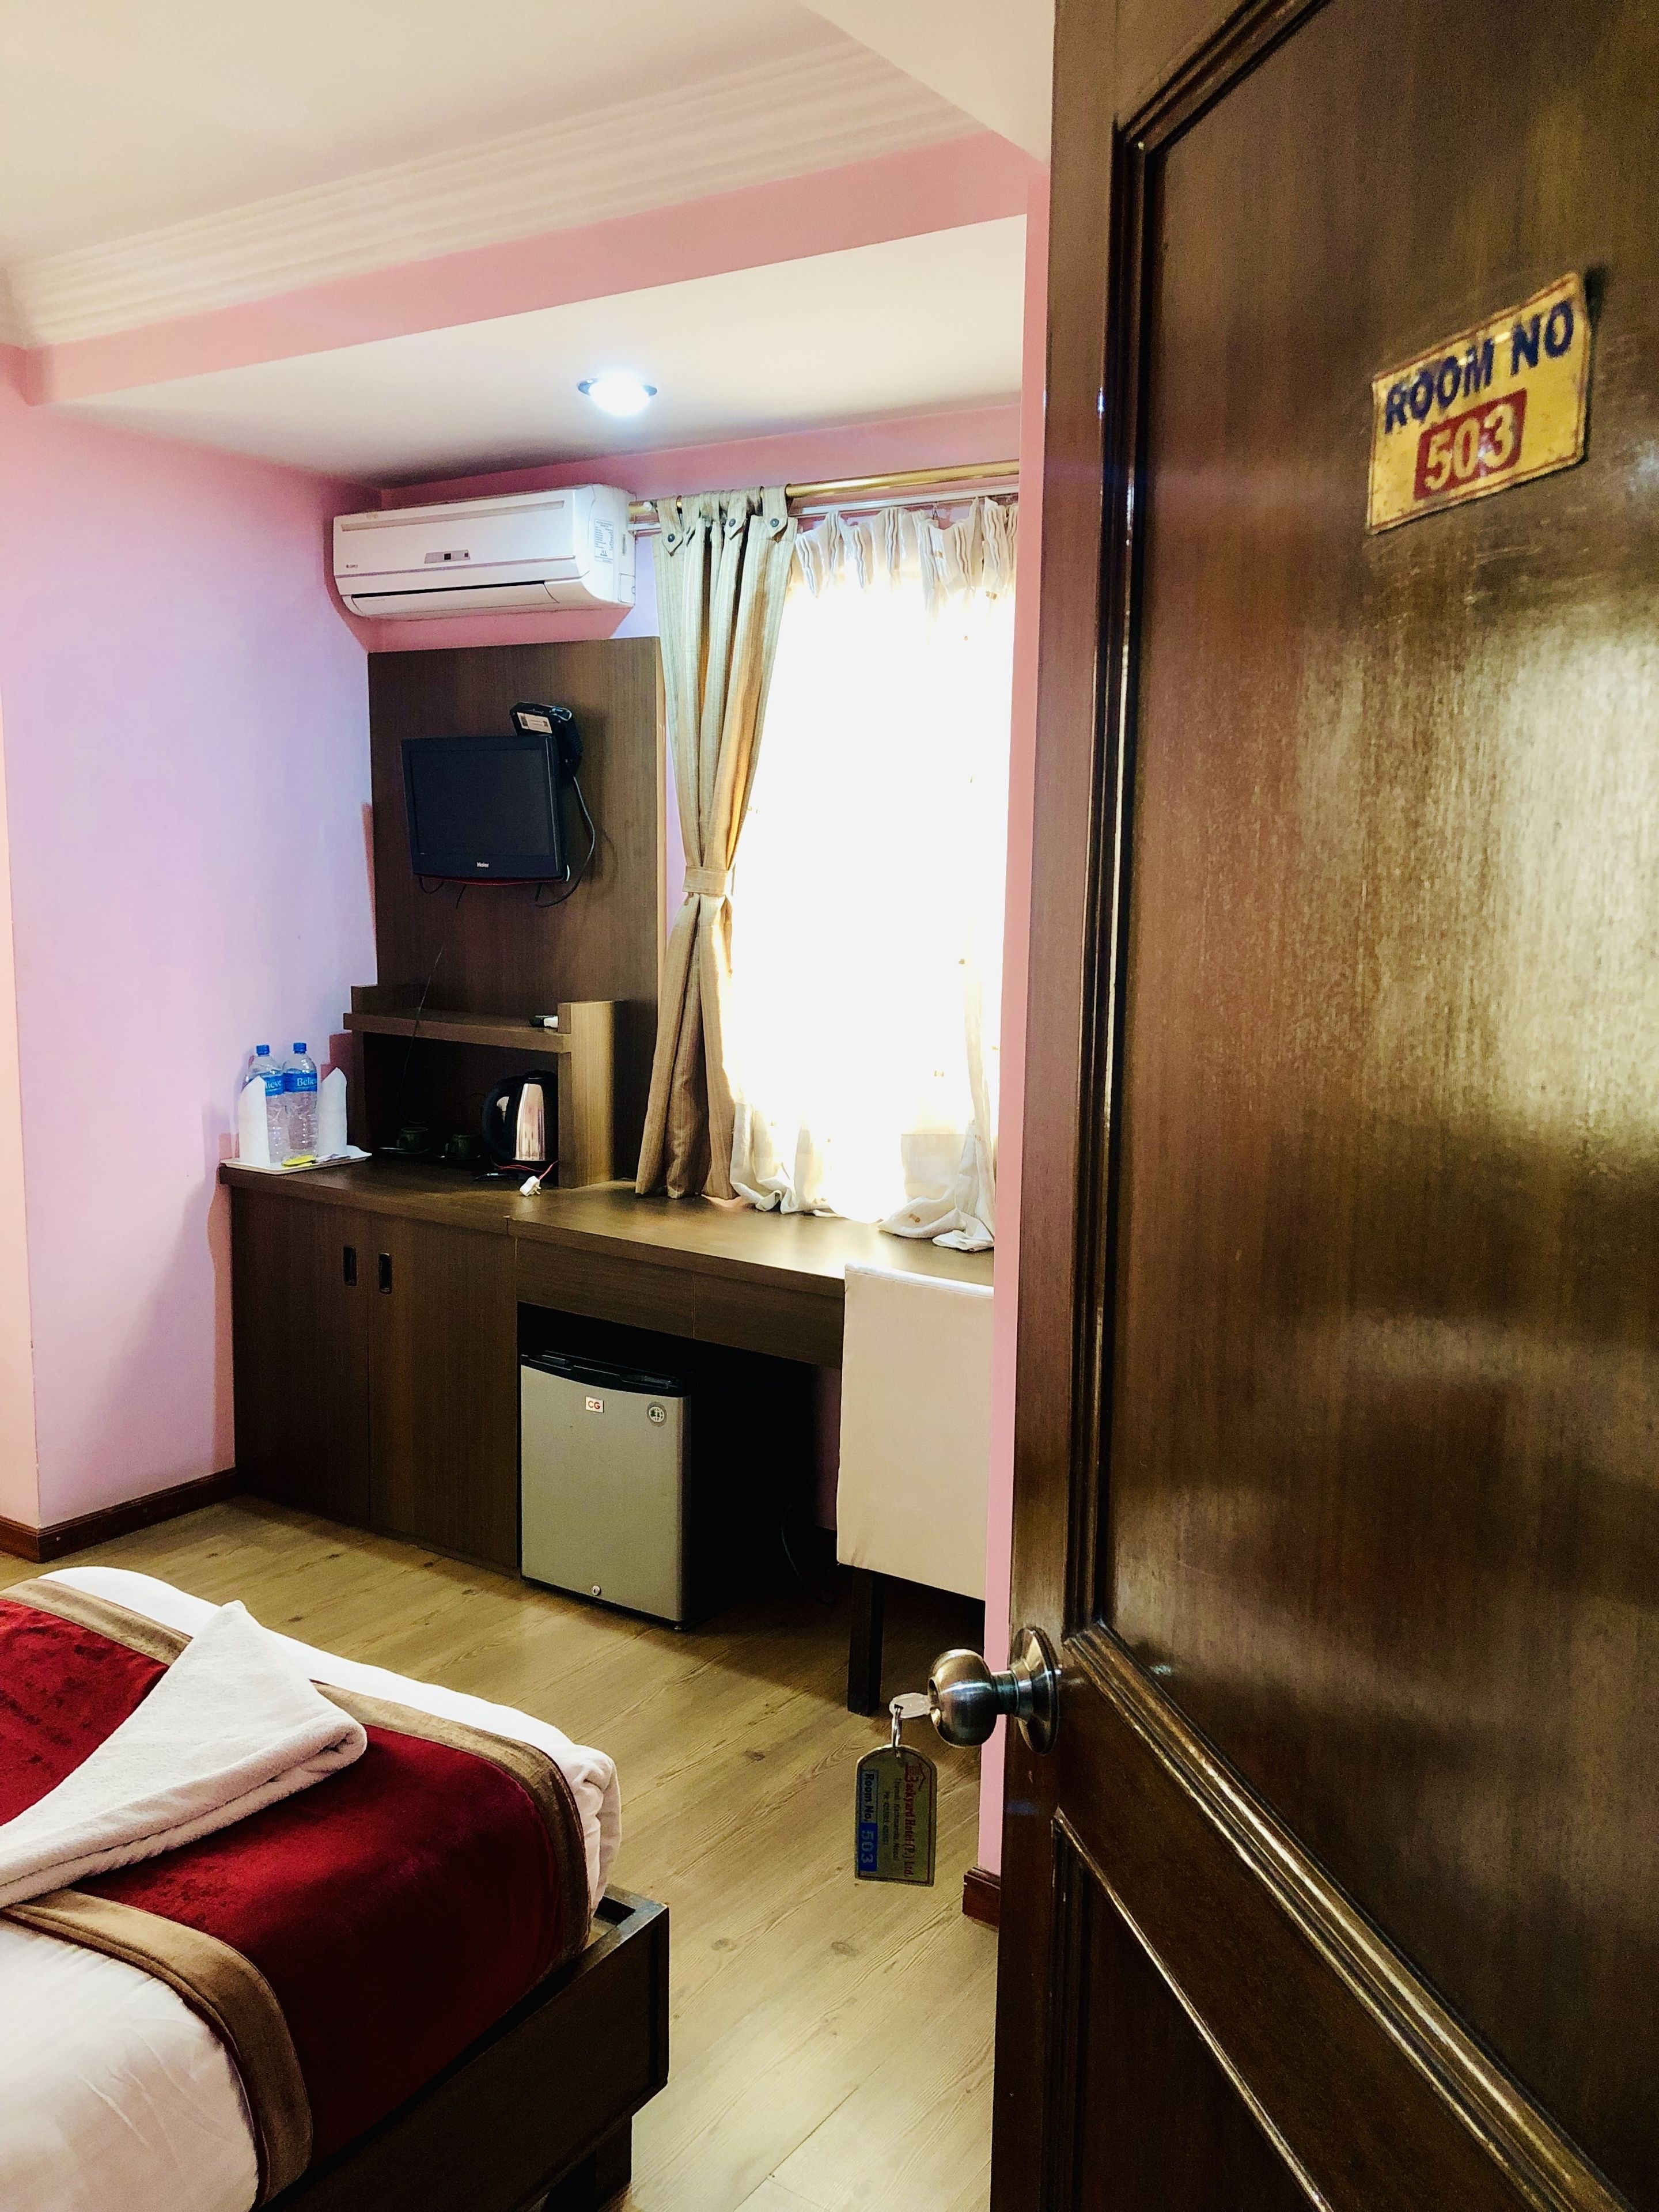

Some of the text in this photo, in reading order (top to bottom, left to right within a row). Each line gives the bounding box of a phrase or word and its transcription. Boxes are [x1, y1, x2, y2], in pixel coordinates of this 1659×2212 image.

[1385, 299, 1574, 435] ROOM NO
[1425, 403, 1515, 490] 503
[588, 1400, 600, 1410] CG
[861, 1774, 874, 1863] Room No. 503
[903, 1819, 916, 1841] Hotel
